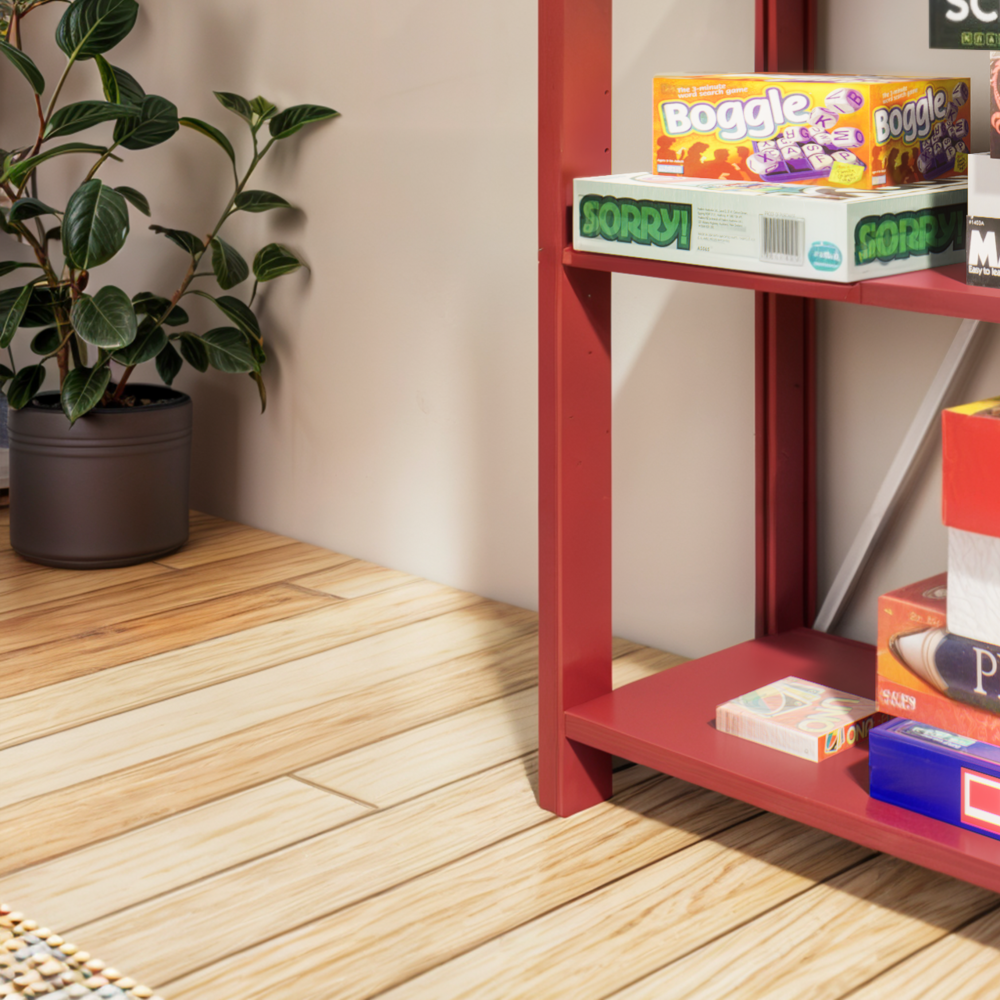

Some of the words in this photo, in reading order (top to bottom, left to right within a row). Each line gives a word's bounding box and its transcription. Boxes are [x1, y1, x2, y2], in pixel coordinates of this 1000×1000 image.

[678, 91, 698, 99] word
[699, 89, 724, 97] search
[726, 87, 748, 96] game
[692, 83, 726, 92] 3-minute
[662, 86, 811, 141] Boggle
[874, 85, 946, 143] Boggle
[580, 196, 691, 248] SORRY!
[968, 265, 983, 276] Easy
[983, 267, 990, 275] to
